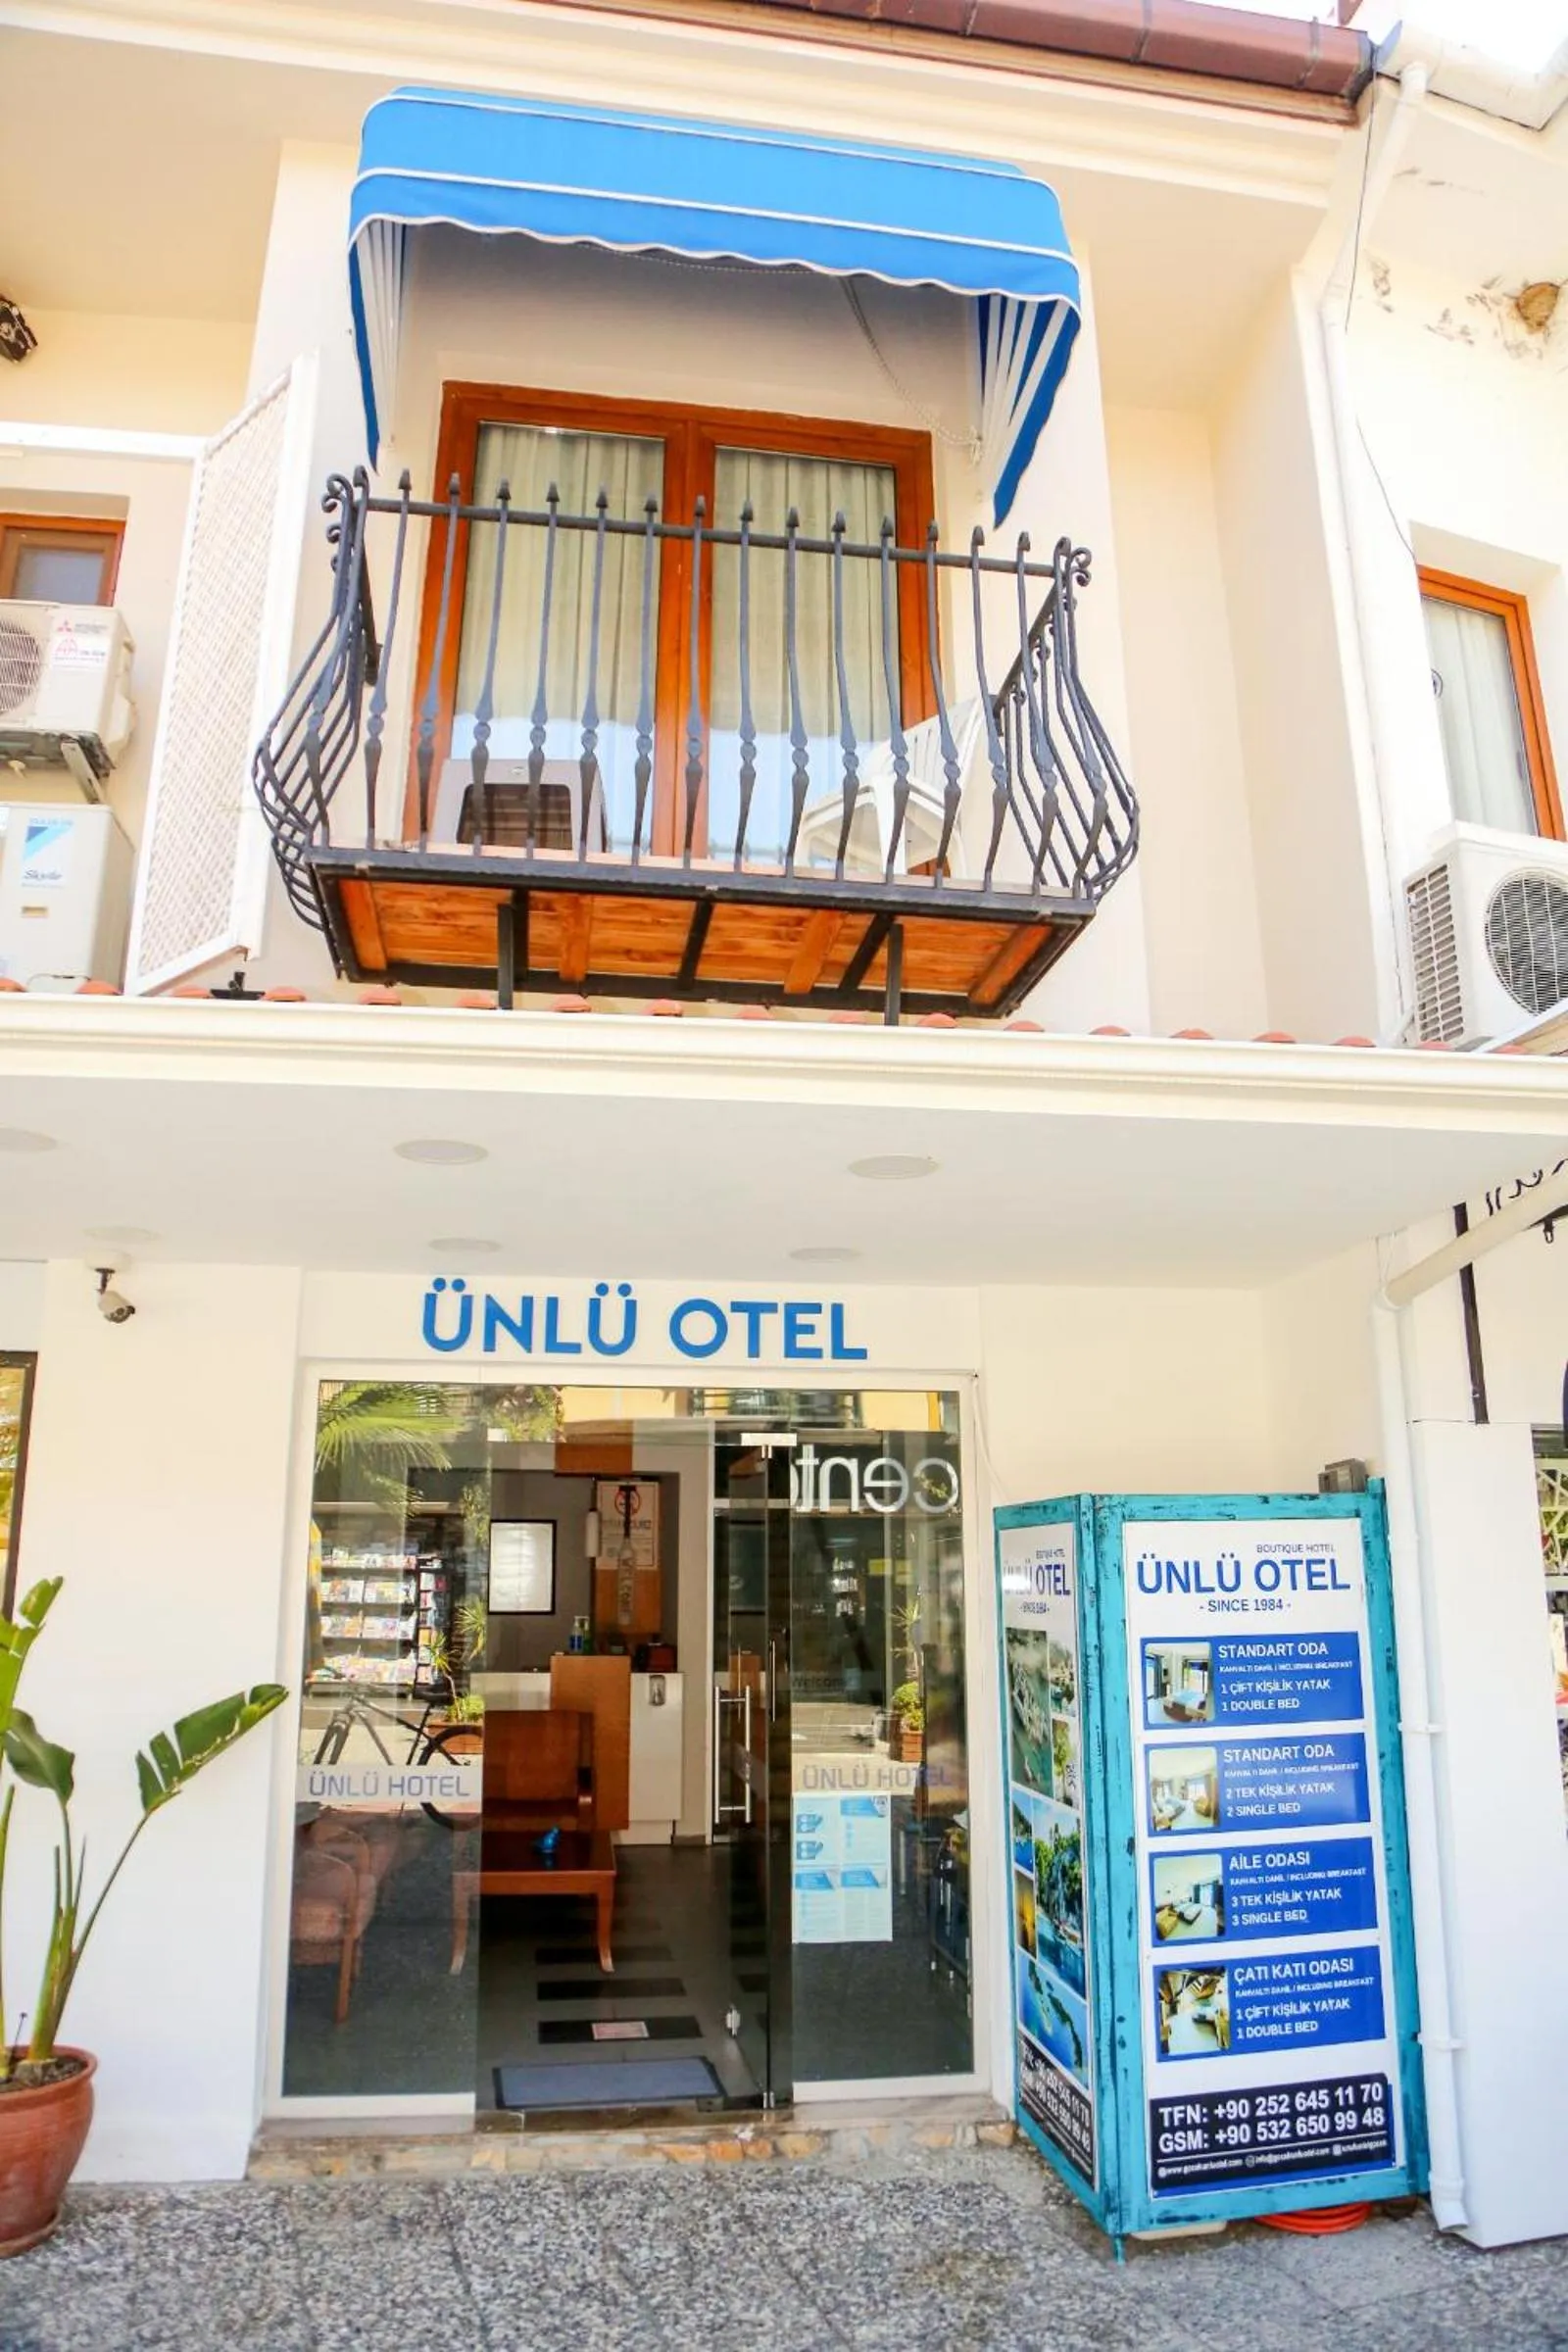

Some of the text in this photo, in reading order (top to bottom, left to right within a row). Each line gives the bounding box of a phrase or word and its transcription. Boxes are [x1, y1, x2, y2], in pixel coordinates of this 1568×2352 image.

[422, 1277, 867, 1359] ÜNLÜ OTEL
[1256, 1544, 1336, 1554] BOUTIQUE HOTEL
[1036, 1563, 1071, 1596] OTEL
[1137, 1552, 1350, 1593] ÜNLÜ OTEL
[1207, 1598, 1250, 1612] SINCE
[1253, 1598, 1284, 1611] 1984
[1218, 1642, 1329, 1658] STANDART ODA
[1221, 1684, 1228, 1694] 1
[1296, 1679, 1331, 1690] YATAK
[1222, 1697, 1299, 1711] 1 DOUBLE BED
[1224, 1743, 1335, 1763] STANDART ODA
[310, 1771, 470, 1796] ÜNLÜ HOTEL
[802, 1764, 954, 1789] ÜNLÜ HOTEL
[1226, 1788, 1232, 1799] 2
[1235, 1787, 1255, 1798] TEK
[1299, 1782, 1336, 1794] YATAK
[1227, 1802, 1300, 1817] 2 SINGLE BED
[1229, 1851, 1310, 1871] AİLE ODASI
[1232, 1896, 1239, 1907] 3
[1241, 1894, 1262, 1906] TEK
[1305, 1887, 1342, 1900] YATAK
[1232, 1909, 1307, 1926] 3 SINGLE BED
[1234, 1958, 1353, 1985] ÇATI KATI ODASI
[1236, 2009, 1244, 2021] 1
[1245, 2004, 1270, 2021] ÇİFT
[1313, 1997, 1350, 2011] YATAK
[1237, 2021, 1318, 2039] 1 DOUBLE BED
[1158, 2082, 1384, 2128] TFN: +90 252 645 11 70
[1158, 2106, 1385, 2153] GSM: +90 532 650 99 48
